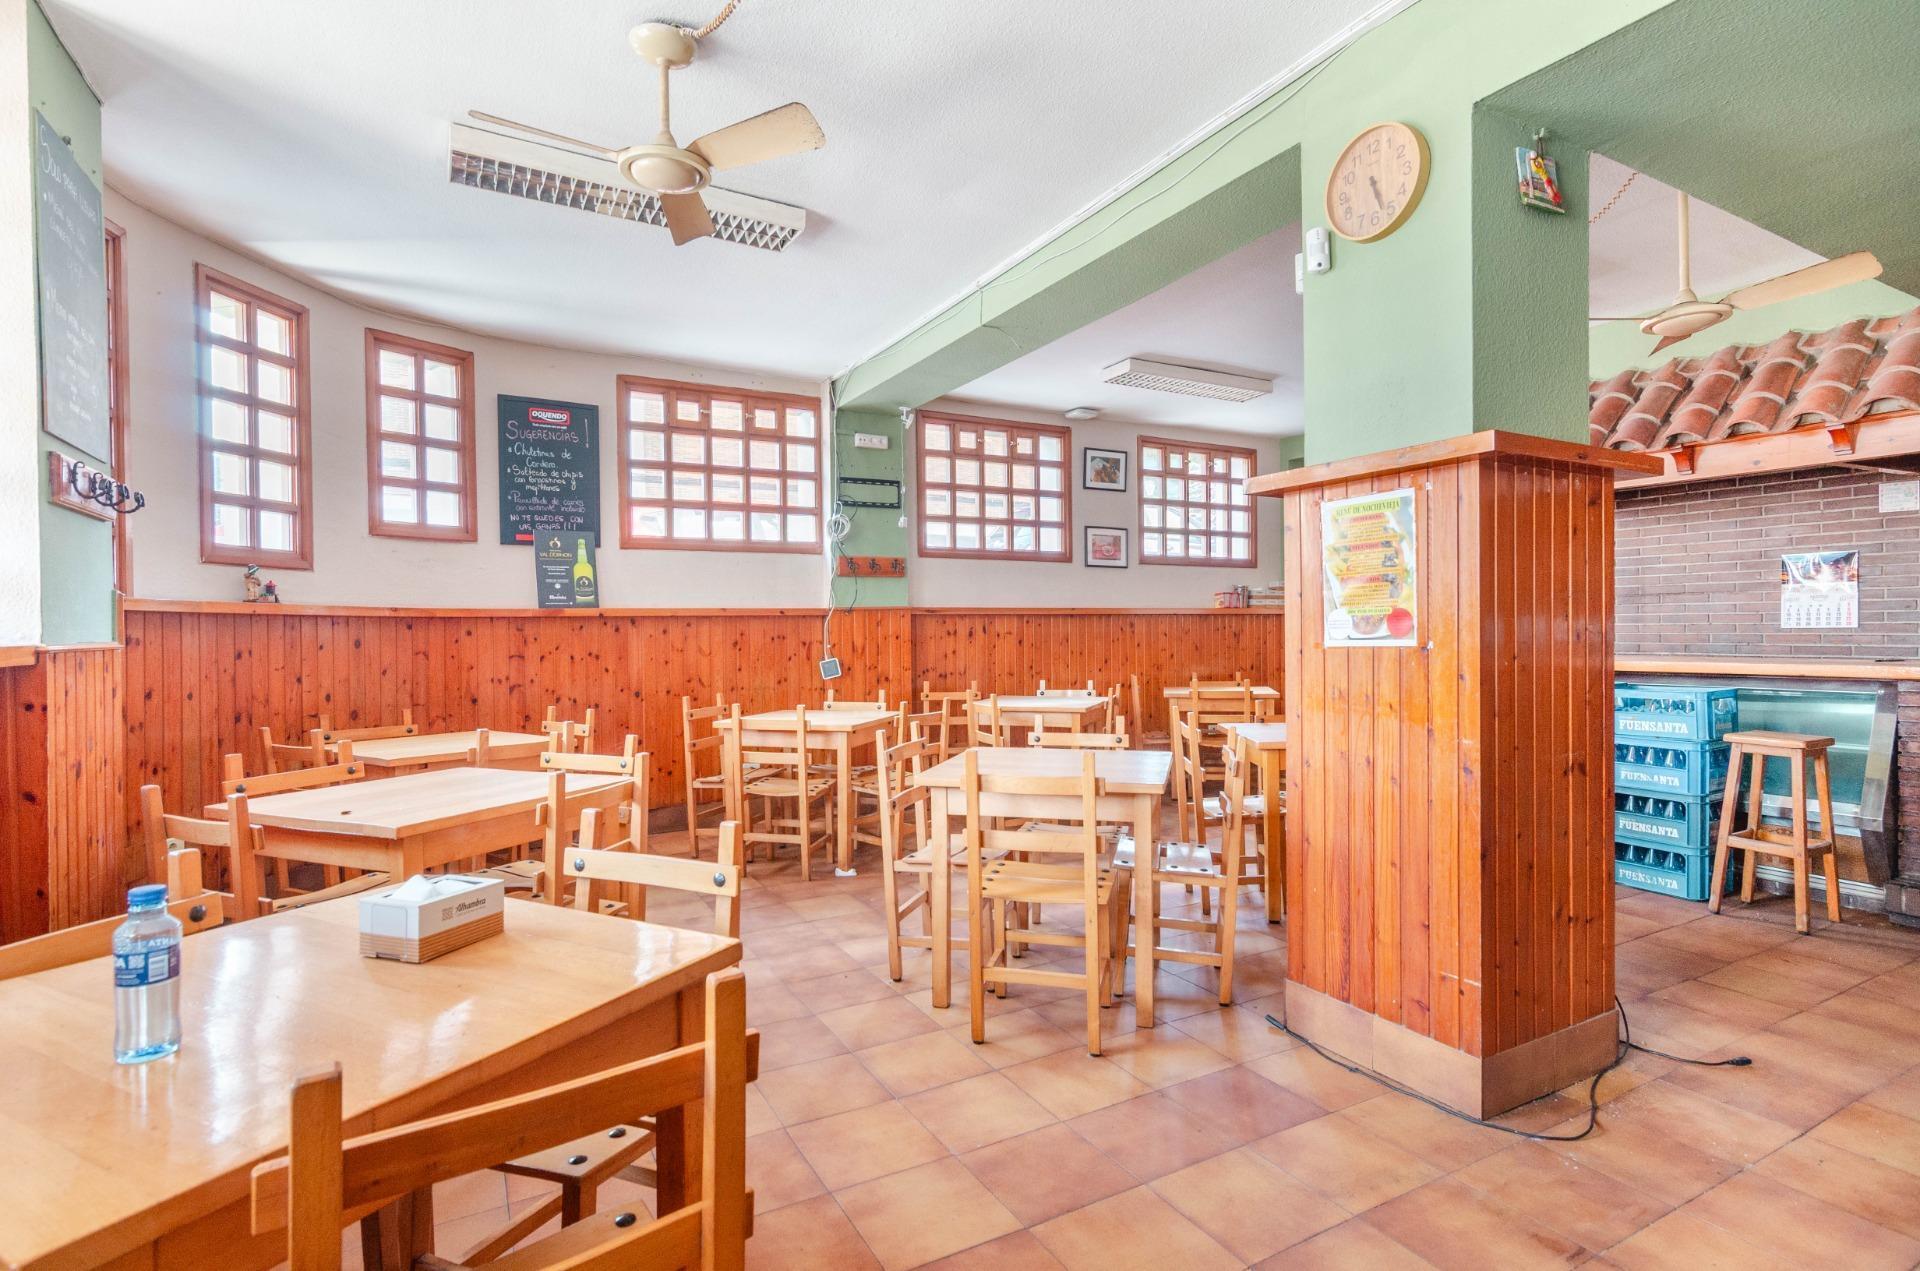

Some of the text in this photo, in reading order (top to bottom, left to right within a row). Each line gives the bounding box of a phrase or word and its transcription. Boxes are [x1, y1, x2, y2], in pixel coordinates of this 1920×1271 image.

[1366, 139, 1380, 155] 12
[1387, 138, 1392, 150] 1
[1396, 145, 1405, 160] 2
[1352, 154, 1362, 168] 11
[1403, 160, 1412, 176] 3
[1343, 171, 1355, 186] 10
[1398, 181, 1407, 196] 4
[1339, 192, 1348, 206] 9
[1344, 206, 1352, 221] 8
[1387, 201, 1396, 216] 5
[1357, 214, 1365, 229] 7
[1370, 211, 1379, 226] 6
[532, 410, 567, 421] OQUENDO
[1619, 719, 1689, 734] FUENSANTA
[1619, 819, 1680, 838] FUENSANTA
[1619, 869, 1679, 890] FUENSANTA
